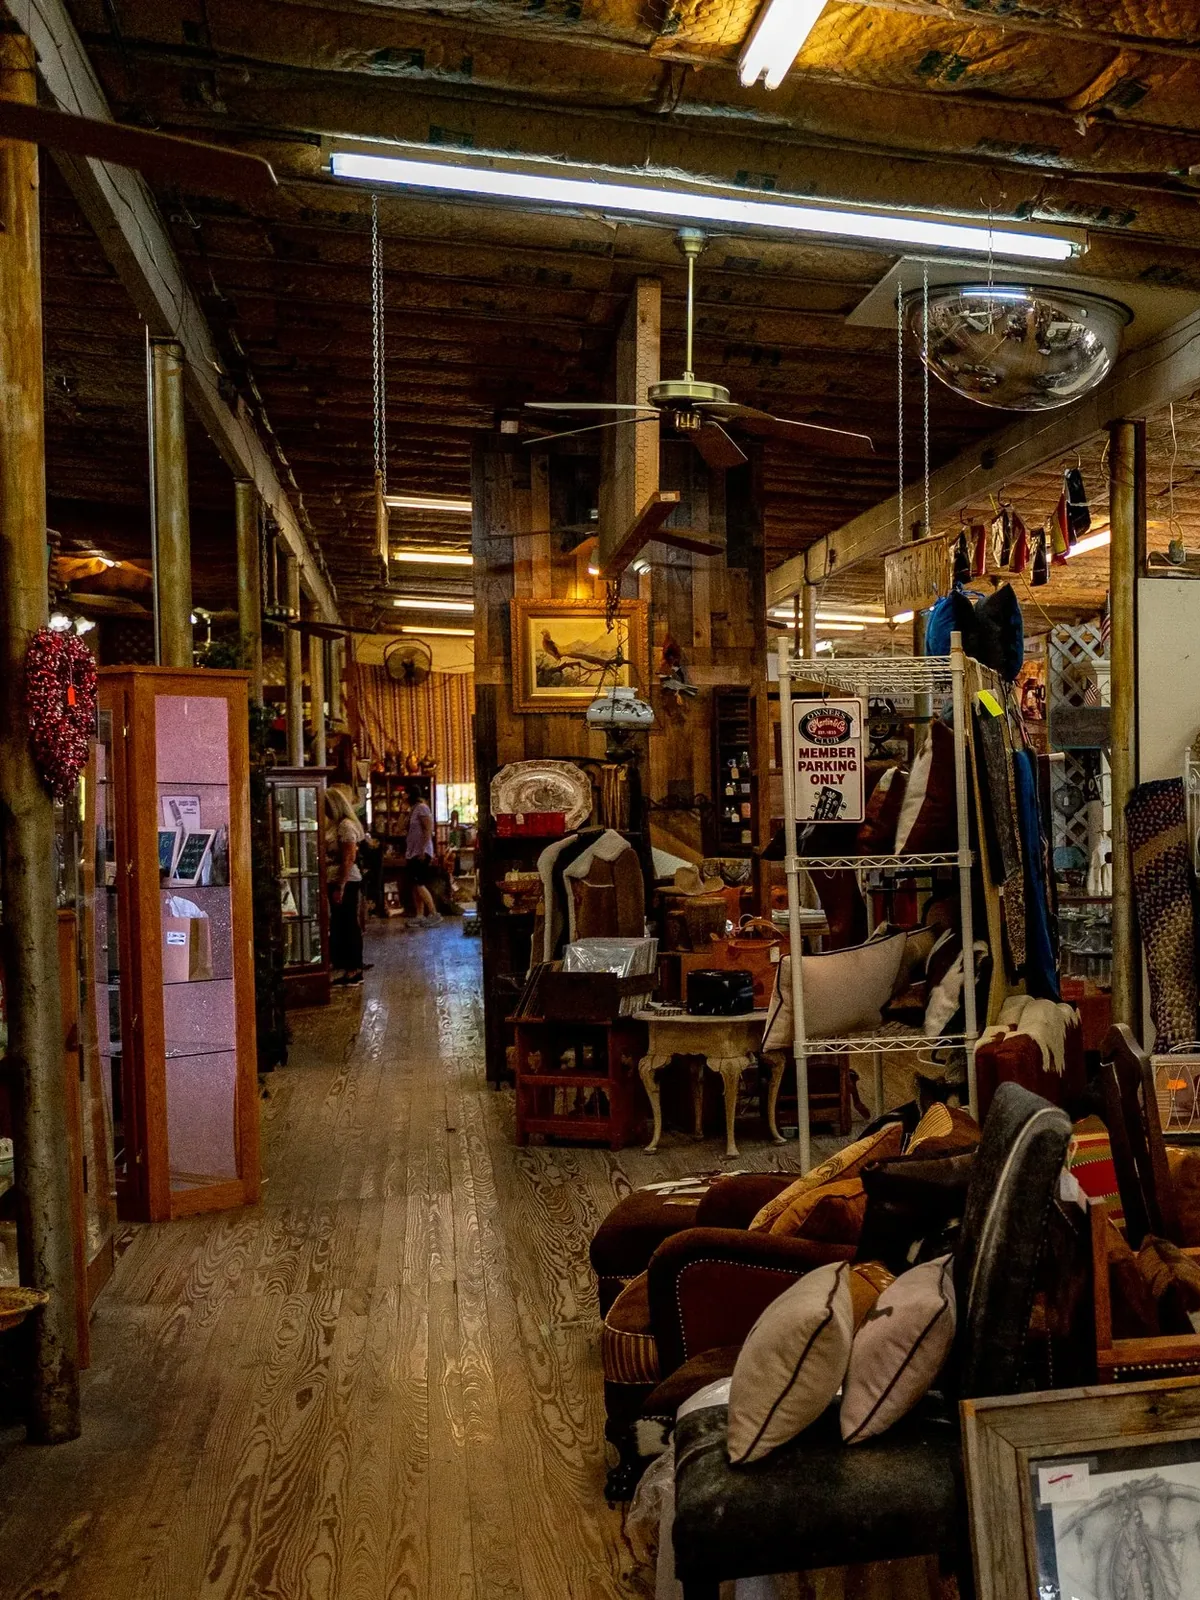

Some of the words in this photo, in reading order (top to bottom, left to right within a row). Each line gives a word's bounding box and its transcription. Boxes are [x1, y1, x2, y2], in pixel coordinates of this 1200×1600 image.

[814, 736, 840, 744] CLUB
[799, 748, 856, 758] MEMBER
[798, 760, 857, 772] PARKING
[810, 774, 845, 785] ONLY
